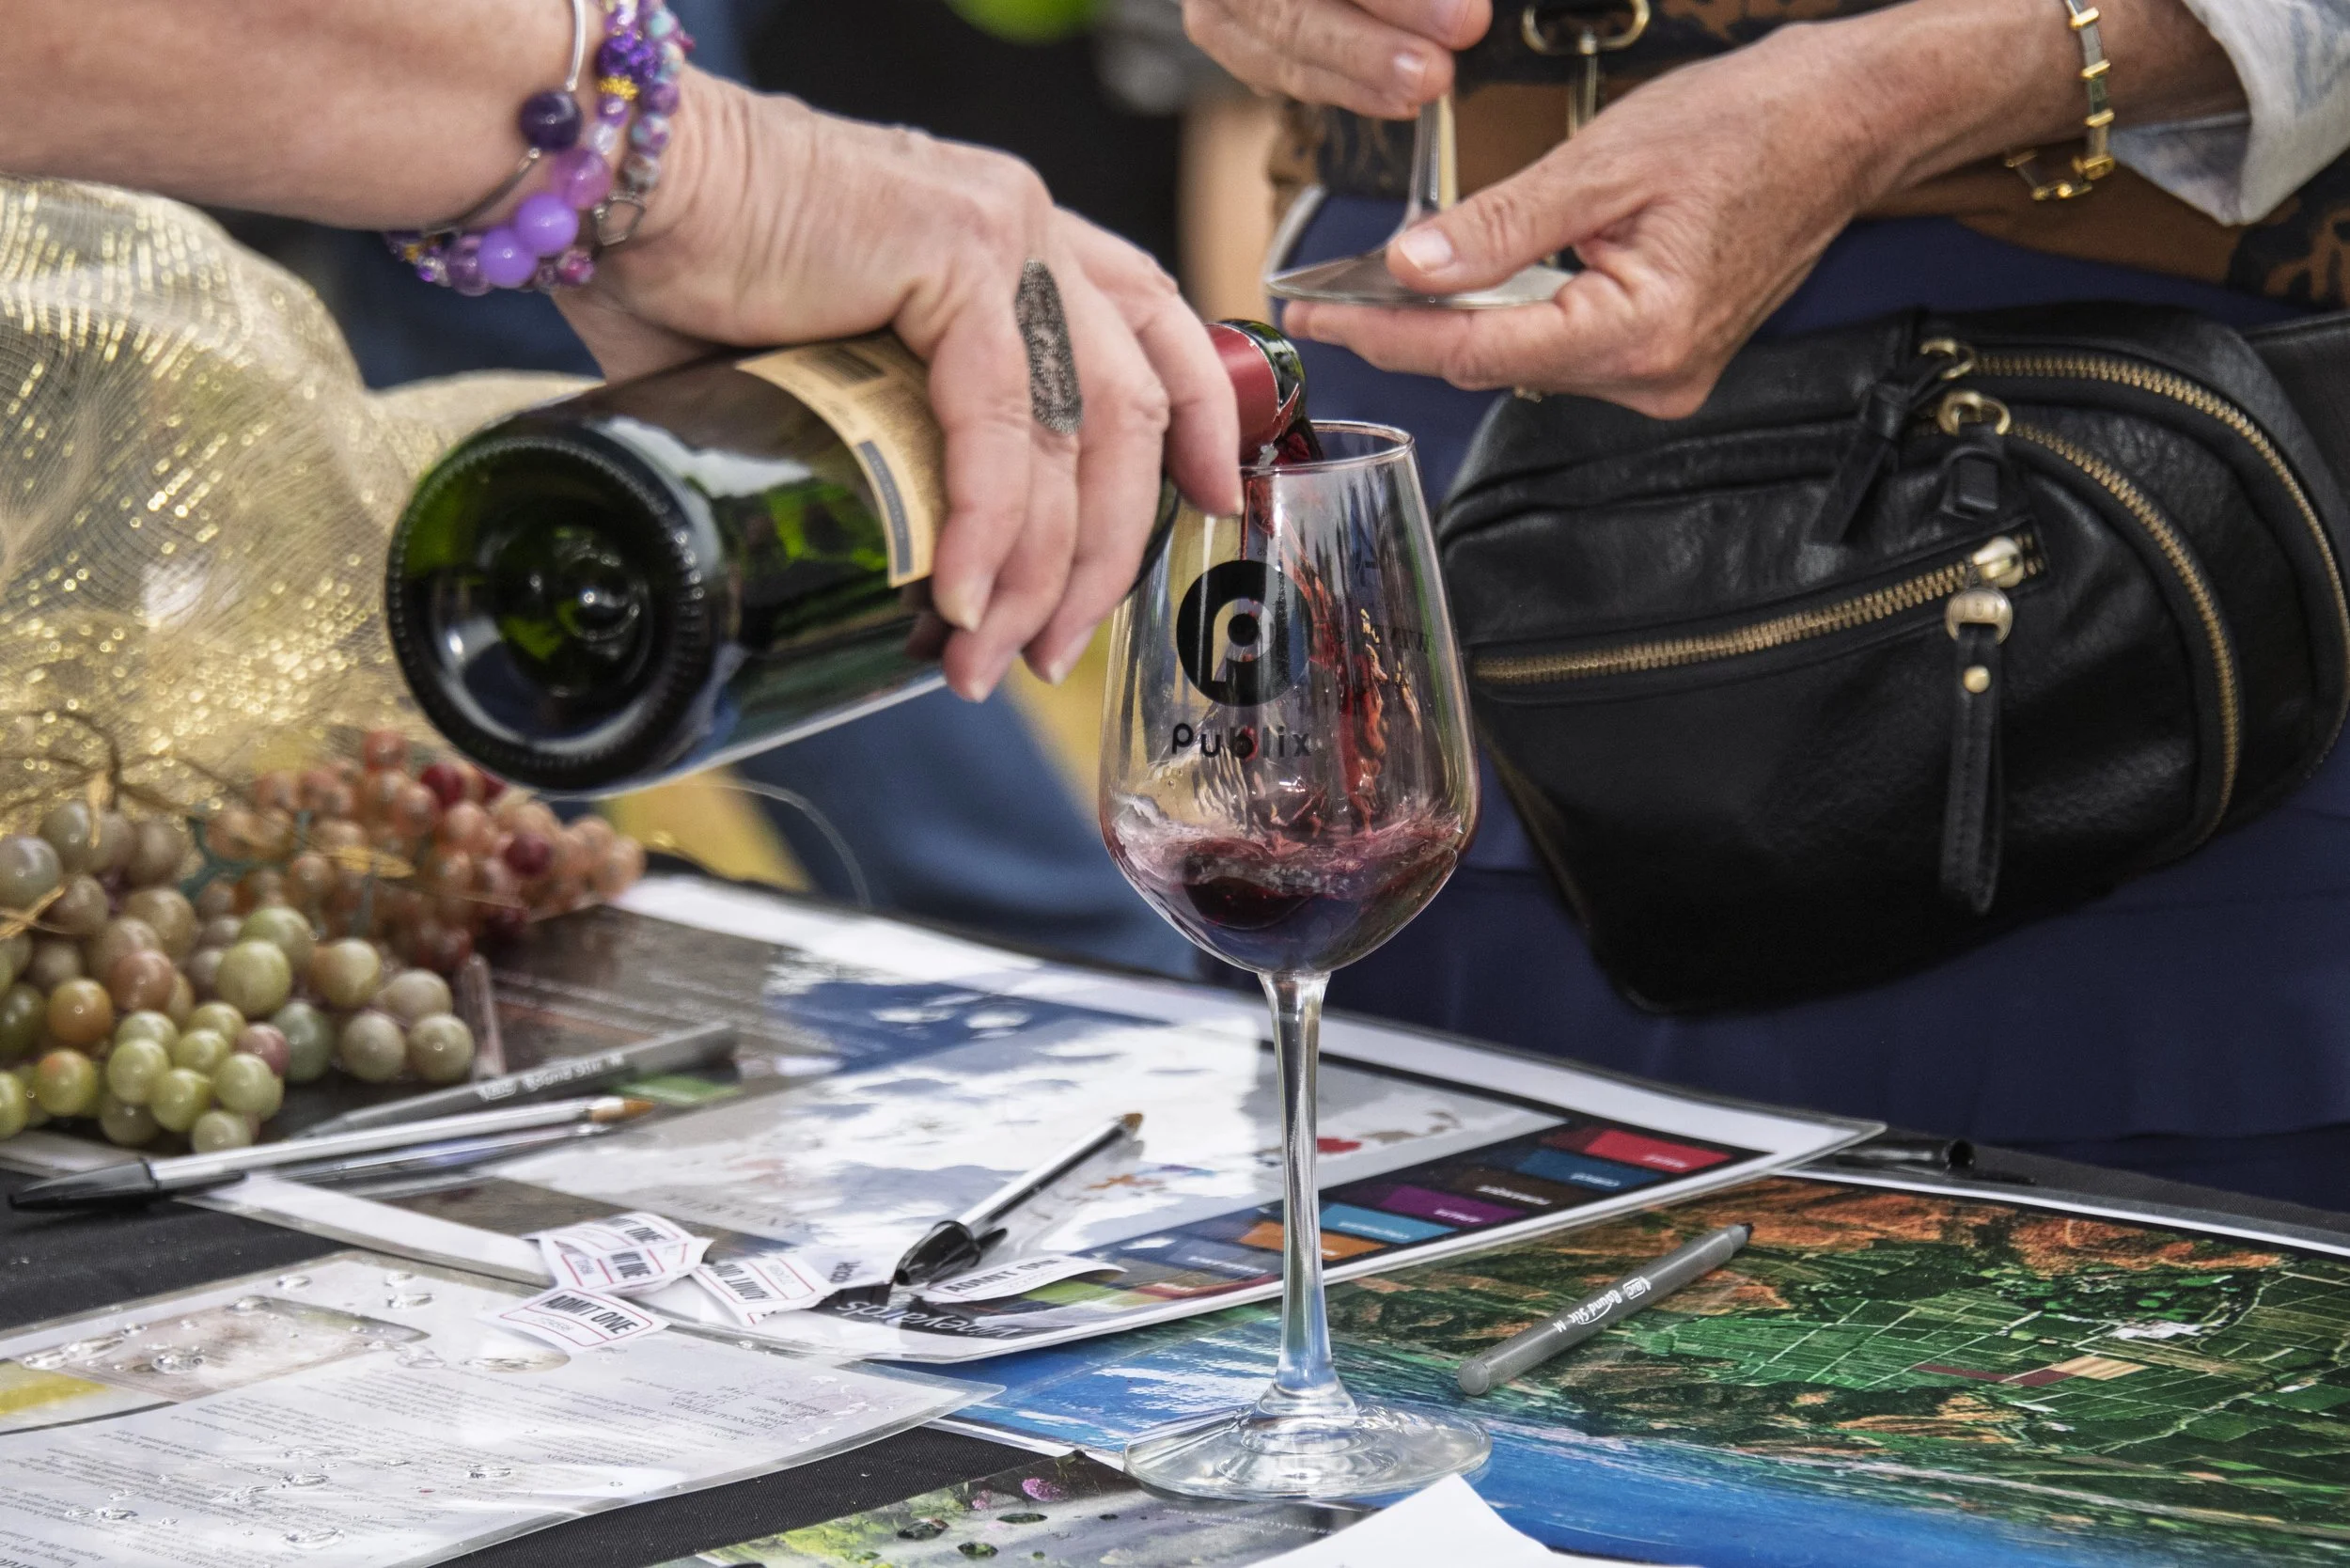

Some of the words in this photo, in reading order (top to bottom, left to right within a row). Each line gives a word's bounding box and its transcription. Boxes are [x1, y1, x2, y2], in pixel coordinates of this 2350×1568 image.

[1172, 723, 1311, 760] Publix
[944, 1270, 1018, 1293] ADMIT
[540, 1294, 606, 1316] ADMIT
[589, 1311, 639, 1335] ONE
[1587, 1289, 1623, 1317] Round
